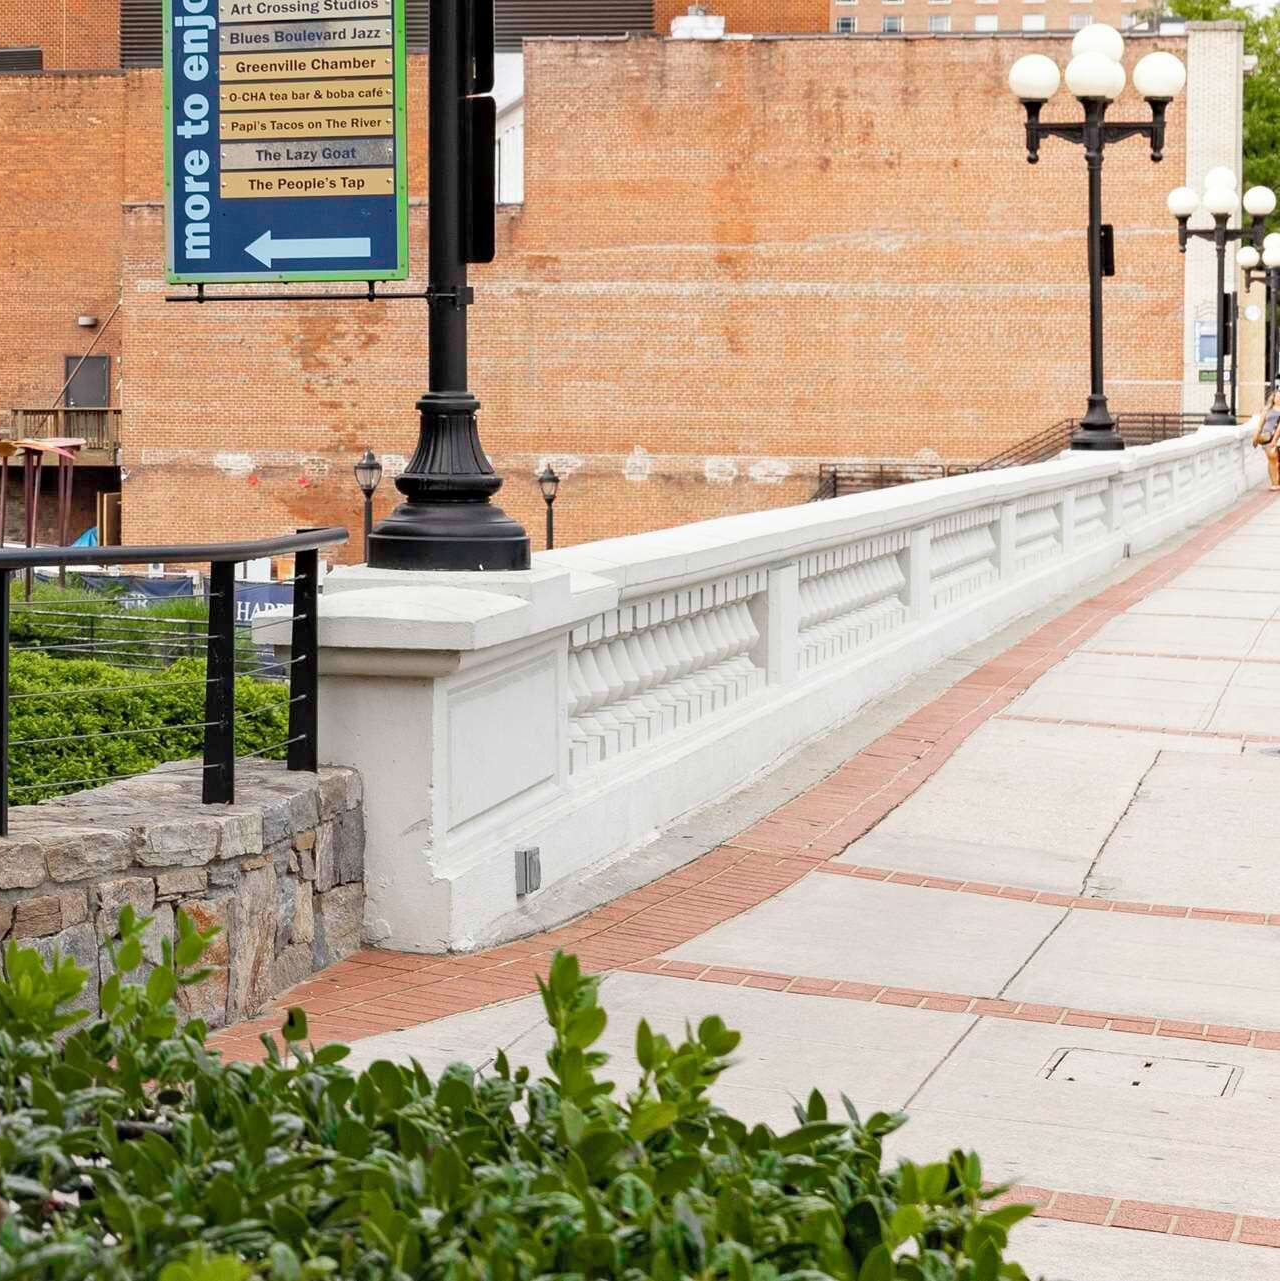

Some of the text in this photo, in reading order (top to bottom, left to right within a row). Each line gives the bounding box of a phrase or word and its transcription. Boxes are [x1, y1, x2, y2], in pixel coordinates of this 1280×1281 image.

[231, 3, 252, 15] Art
[256, 0, 320, 14] Crossing
[230, 28, 381, 45] Blues Boulevard Jazz
[236, 57, 376, 73] Greenville Chamber
[229, 87, 383, 102] O-CHA tea bar & boba café
[176, 93, 210, 139] to
[231, 117, 381, 132] Papi's Tacos on The River
[256, 147, 356, 162] The Lazy Goat
[248, 176, 365, 191] The People's Tap
[184, 149, 211, 259] more
